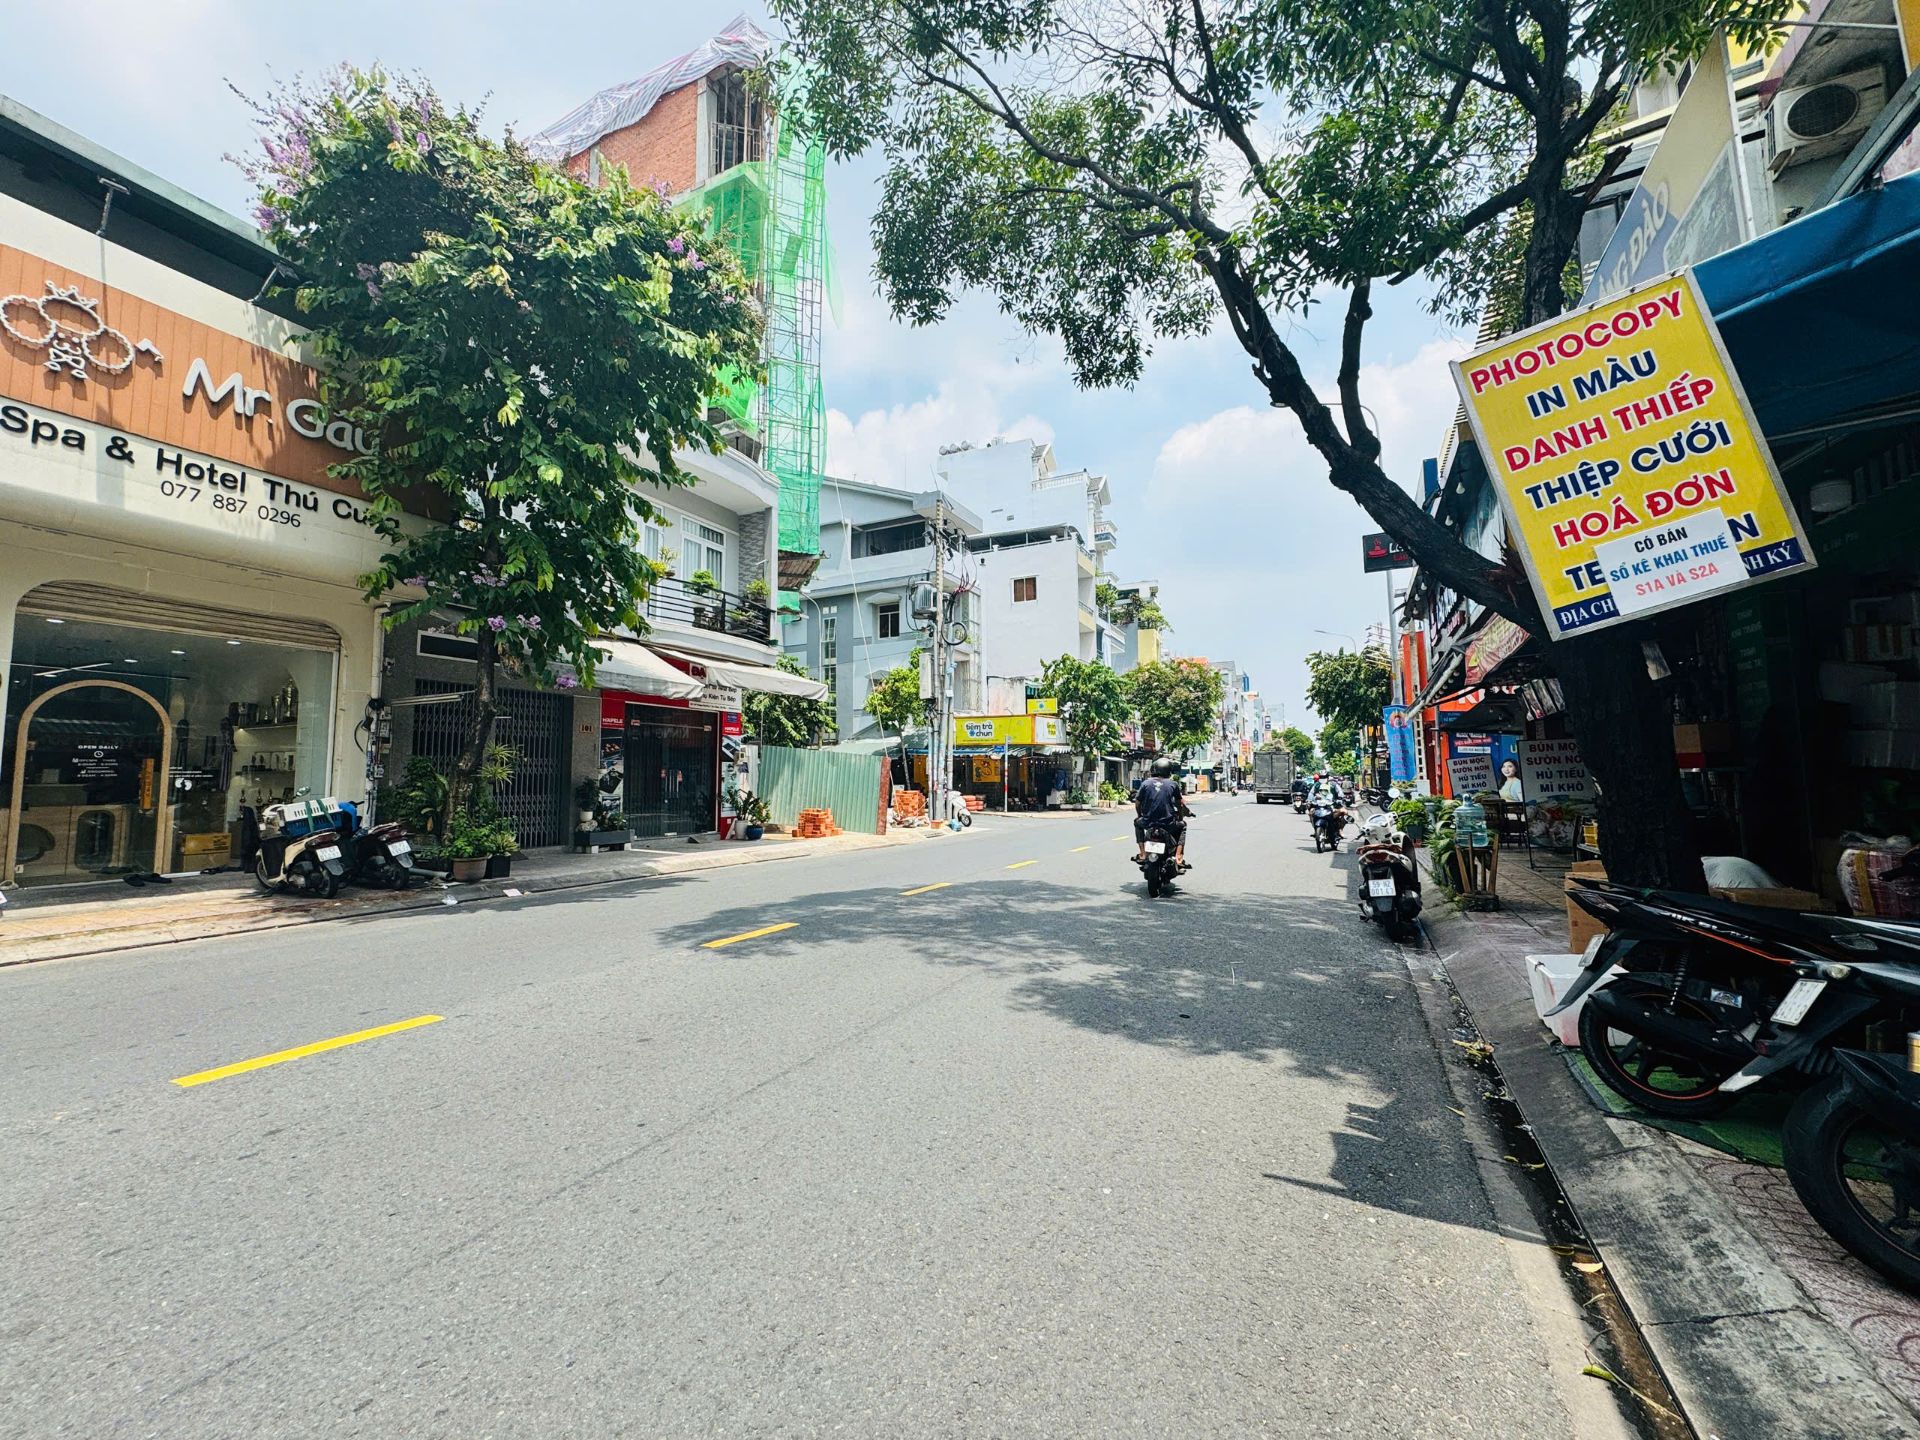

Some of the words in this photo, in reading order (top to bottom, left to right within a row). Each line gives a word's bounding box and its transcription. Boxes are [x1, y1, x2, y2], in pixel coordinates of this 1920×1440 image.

[1470, 291, 1682, 394] PHOTOCOPY
[1526, 385, 1566, 418] IN
[1573, 350, 1657, 401] MÀU
[1504, 417, 1607, 472] DANH
[1612, 373, 1714, 434] THIẾP
[1, 405, 86, 451] Spa
[105, 434, 135, 464] &
[156, 447, 246, 493] Hotel
[263, 476, 319, 513] Thú
[1524, 461, 1620, 510] THIỆP
[1631, 421, 1731, 473] CƯỚI
[160, 480, 201, 503] 077
[212, 493, 247, 515] 887
[257, 504, 301, 528] 0296
[1552, 496, 1639, 548] HOÁ
[1645, 469, 1735, 518] ĐƠN
[1610, 561, 1630, 583] SỔ
[1634, 558, 1652, 577] KÊ
[1654, 552, 1689, 572] KHAI
[1692, 532, 1729, 557] THUẾ
[1634, 536, 1653, 554] CÓ
[1659, 526, 1688, 547] BÁN
[1560, 607, 1589, 627] ĐỊA
[1590, 598, 1617, 617] CH
[1765, 544, 1794, 569] KÝ
[1565, 560, 1606, 591] TE
[1635, 578, 1664, 597] S1A
[1668, 571, 1687, 588] VÀ
[1690, 562, 1720, 582] S2A
[1536, 768, 1553, 779] HỦ
[1557, 767, 1585, 779] TIẾU
[1565, 755, 1584, 764] NO
[1558, 781, 1584, 791] KHÔ
